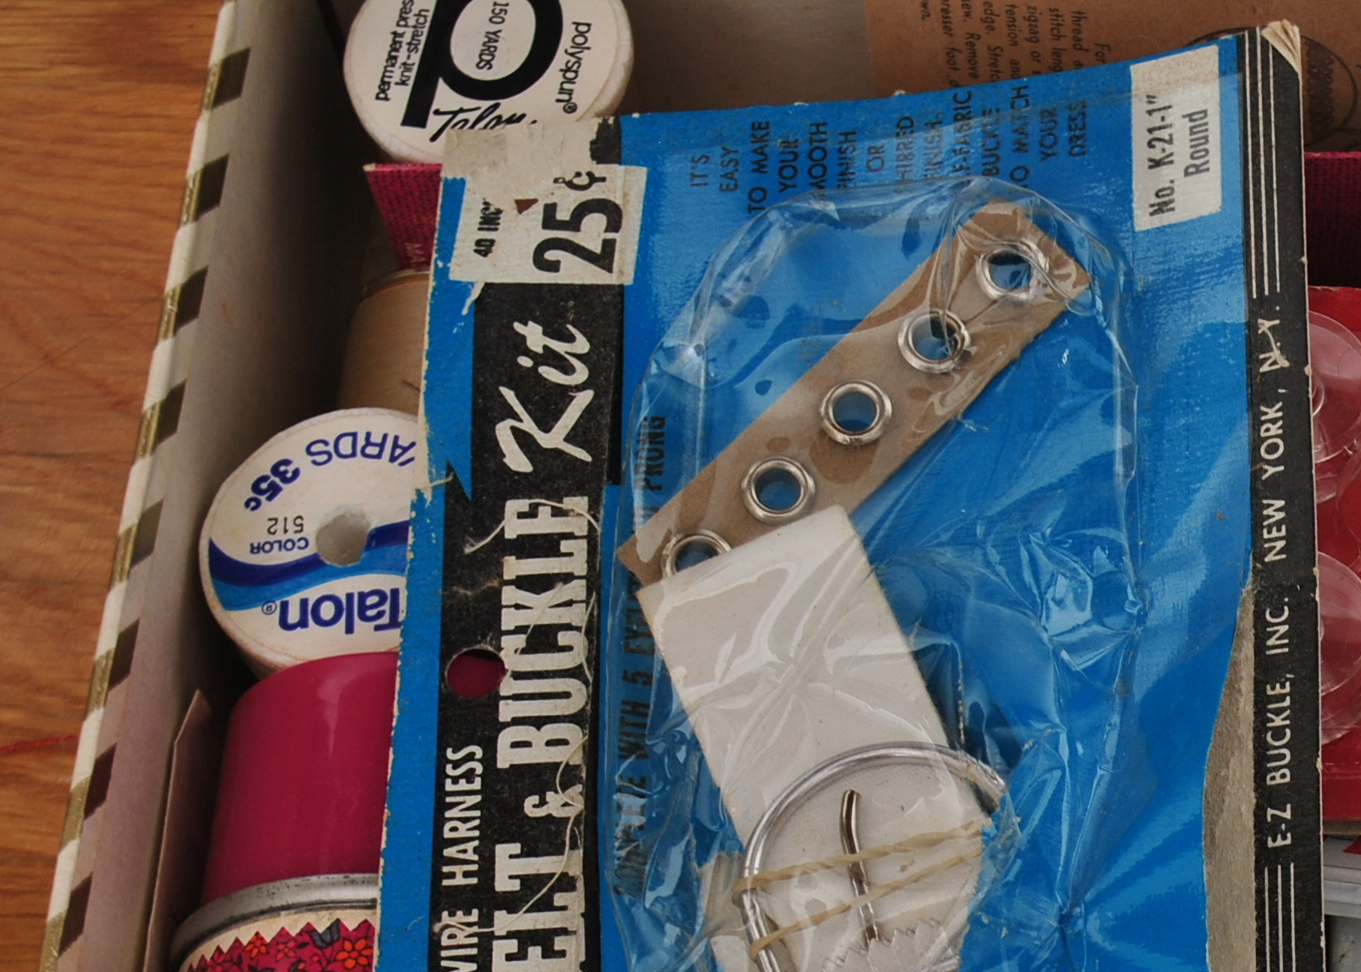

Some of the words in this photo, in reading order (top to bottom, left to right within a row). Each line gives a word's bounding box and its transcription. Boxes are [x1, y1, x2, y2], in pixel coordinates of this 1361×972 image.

[488, 2, 509, 25] 150
[1004, 4, 1019, 47] tension
[376, 30, 402, 101] permanent
[395, 9, 430, 87] knit-stretch
[476, 29, 502, 71] YARDS
[964, 32, 981, 80] Remove
[751, 121, 770, 174] MAKE
[866, 144, 884, 172] OR
[1039, 106, 1058, 161] YOUR
[1182, 109, 1210, 177] Round
[690, 154, 709, 187] IT'S
[719, 146, 740, 192] EASY
[778, 139, 798, 193] YOUR
[748, 186, 767, 214] TO
[1149, 179, 1175, 216] No.
[1258, 306, 1284, 373] N.Y.
[495, 320, 594, 473] Kit
[305, 431, 417, 467] ARDS
[634, 415, 666, 492] PRONG
[1260, 388, 1289, 481] YORK,
[249, 536, 310, 555] COLOR
[267, 515, 305, 535] 512
[1262, 499, 1287, 563] NEW
[496, 496, 590, 768] BUCKLE
[1265, 596, 1290, 655] INC.
[622, 670, 651, 687] 5
[618, 699, 648, 760] WITH
[1266, 672, 1295, 786] BUCKLE,
[442, 743, 483, 887] HARNESS
[524, 781, 584, 818] &
[1267, 803, 1292, 849] E-Z
